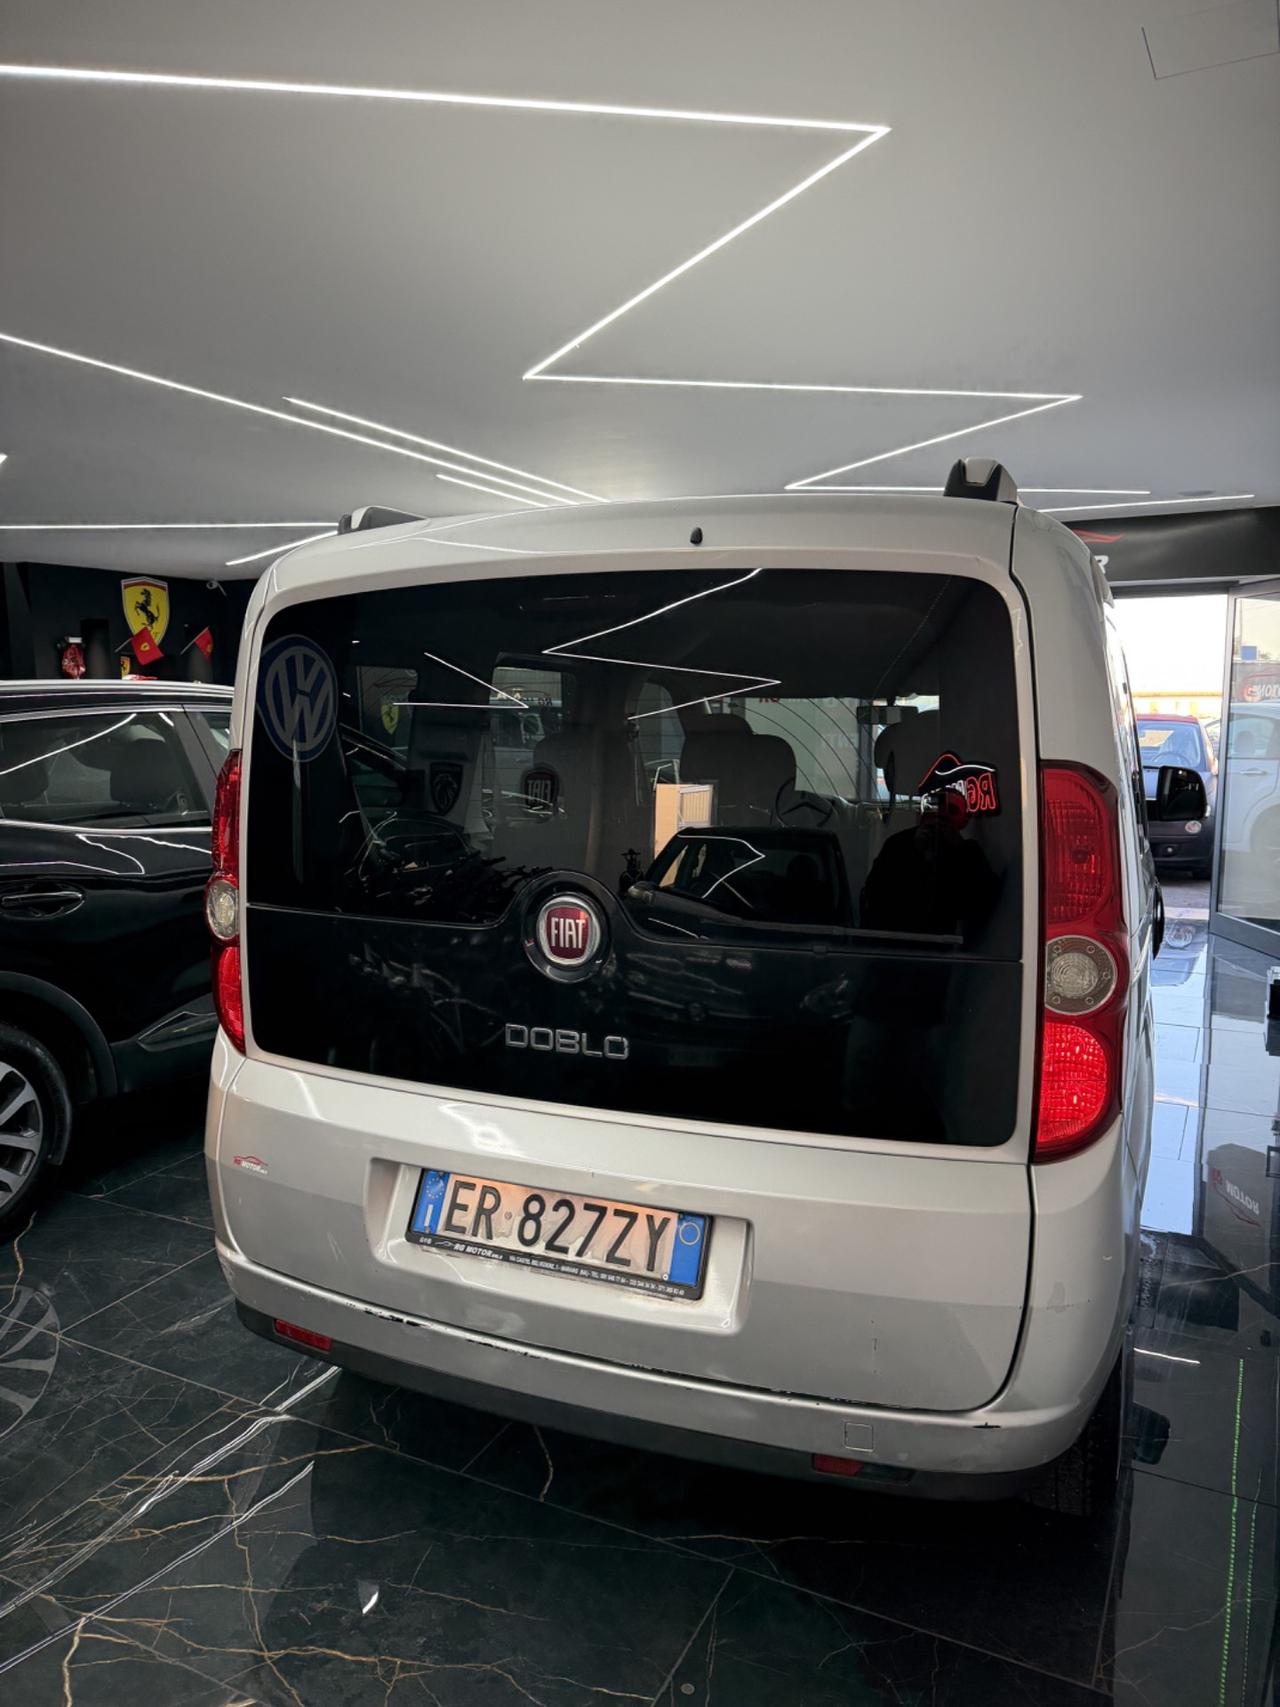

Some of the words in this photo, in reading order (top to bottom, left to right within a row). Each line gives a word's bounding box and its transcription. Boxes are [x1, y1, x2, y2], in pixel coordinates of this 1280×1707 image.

[551, 917, 585, 949] FIAT
[505, 1023, 629, 1060] DOBLO
[444, 1180, 501, 1240] ER
[518, 1193, 671, 1272] 827ZY
[453, 1243, 466, 1251] RG
[466, 1245, 493, 1257] MOTOR
